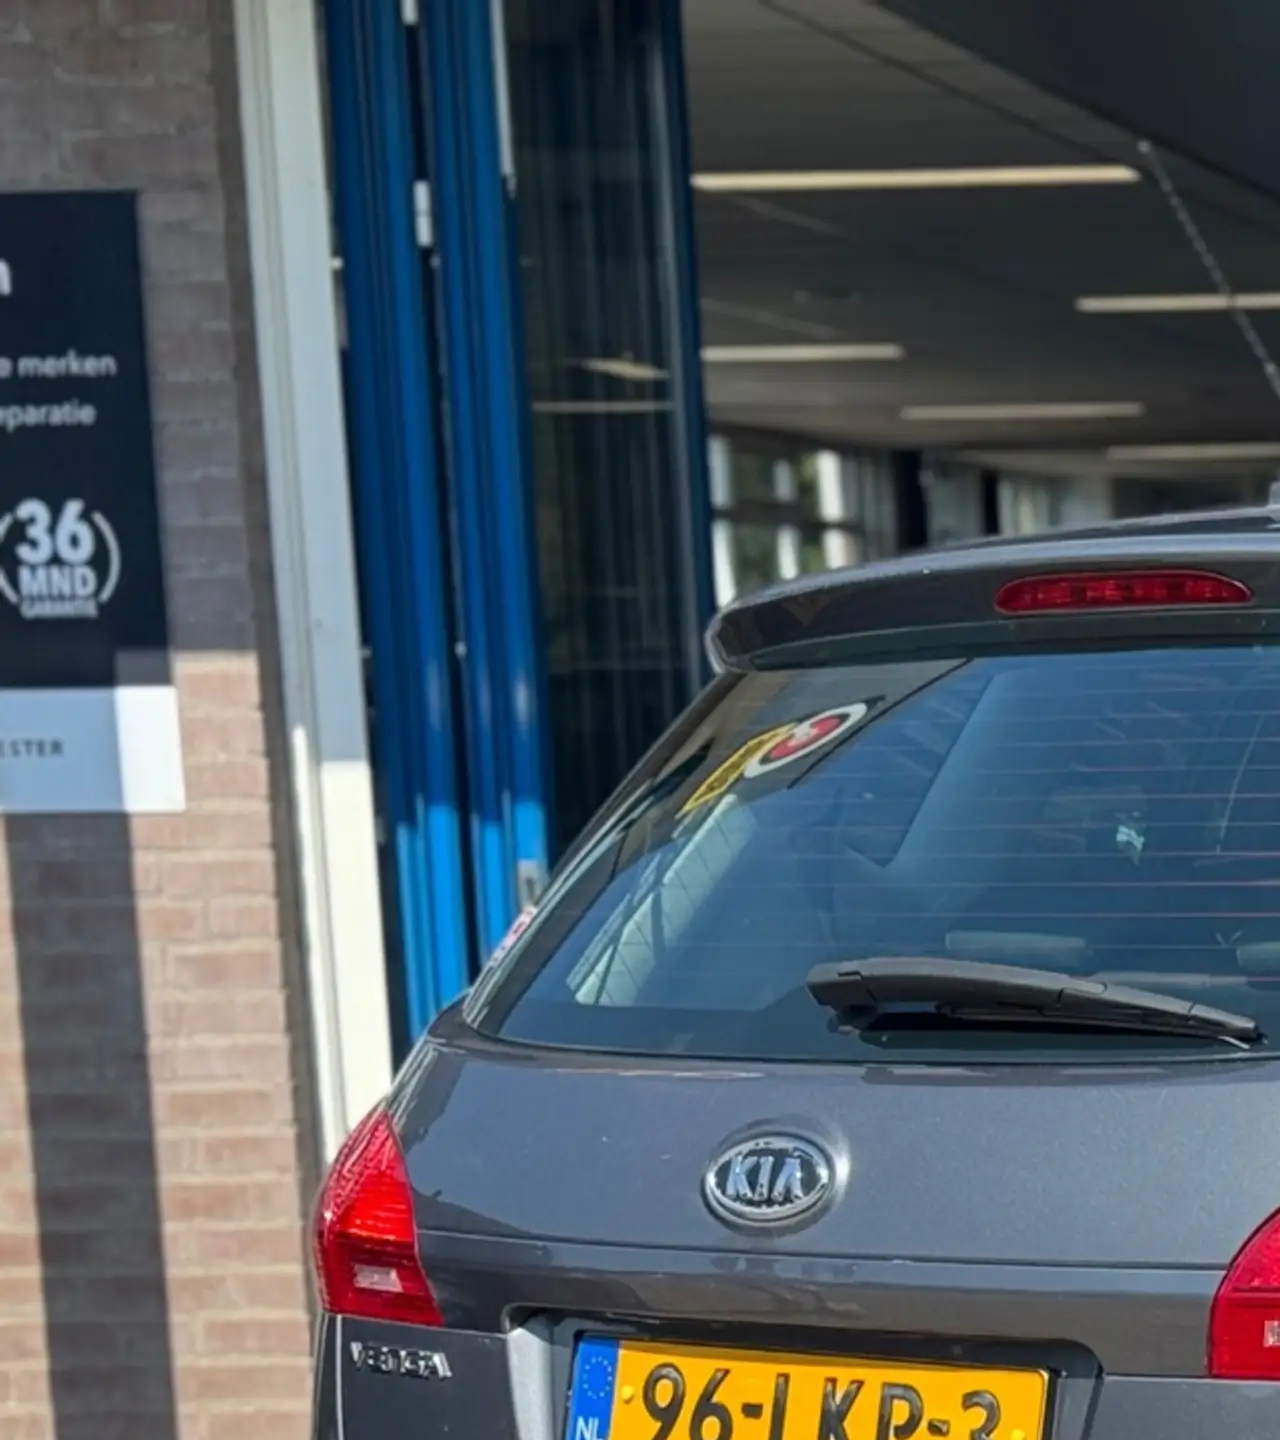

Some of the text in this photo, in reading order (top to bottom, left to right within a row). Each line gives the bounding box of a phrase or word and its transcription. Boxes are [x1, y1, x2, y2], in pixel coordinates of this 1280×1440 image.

[18, 348, 118, 377] merken
[15, 497, 95, 565] 36
[17, 564, 98, 599] MND
[725, 1155, 804, 1202] KIA
